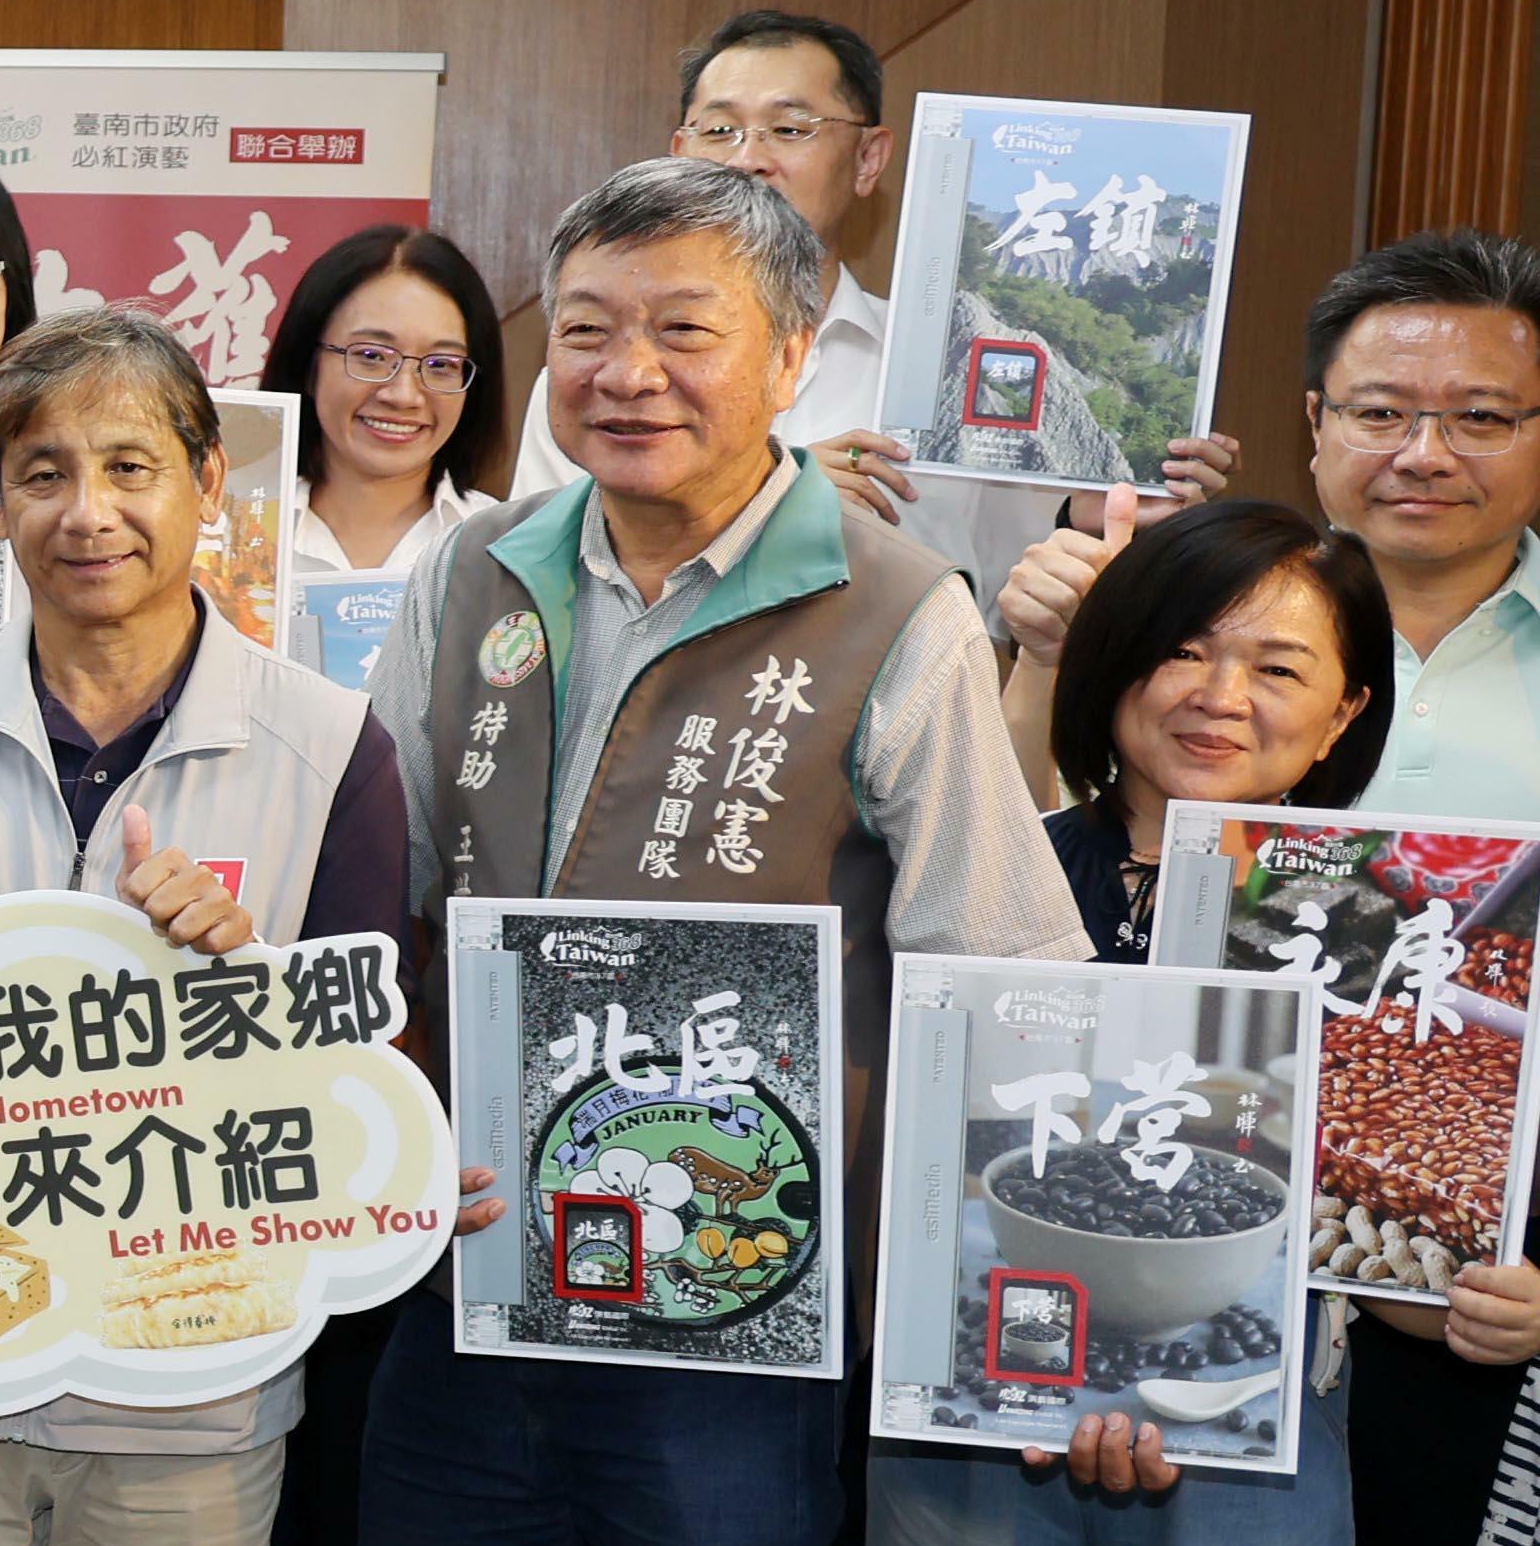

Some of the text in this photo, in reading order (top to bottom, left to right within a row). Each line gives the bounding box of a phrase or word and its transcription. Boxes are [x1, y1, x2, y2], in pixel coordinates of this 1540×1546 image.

[73, 113, 220, 138] 臺南市政府
[72, 145, 190, 169] 必紅演藝
[237, 134, 357, 159] 聯合舉辦
[1005, 134, 1073, 156] Taiwan
[981, 170, 1167, 268] 左鎮
[455, 700, 509, 791] 特助
[706, 654, 815, 875] 林俊憲
[638, 714, 718, 880] 服務團隊
[1276, 837, 1330, 859] Linking
[1272, 851, 1353, 877] Taiwan
[558, 930, 611, 950] Linking
[556, 943, 636, 967] Taiwan
[1015, 990, 1070, 1013] Linking
[1011, 1004, 1097, 1030] Taiwan
[549, 990, 760, 1098] 北區
[601, 1109, 704, 1140] JANUARY
[991, 1051, 1212, 1193] 下營
[108, 1202, 440, 1259] Let Me Show You
[573, 1218, 618, 1241] 北區
